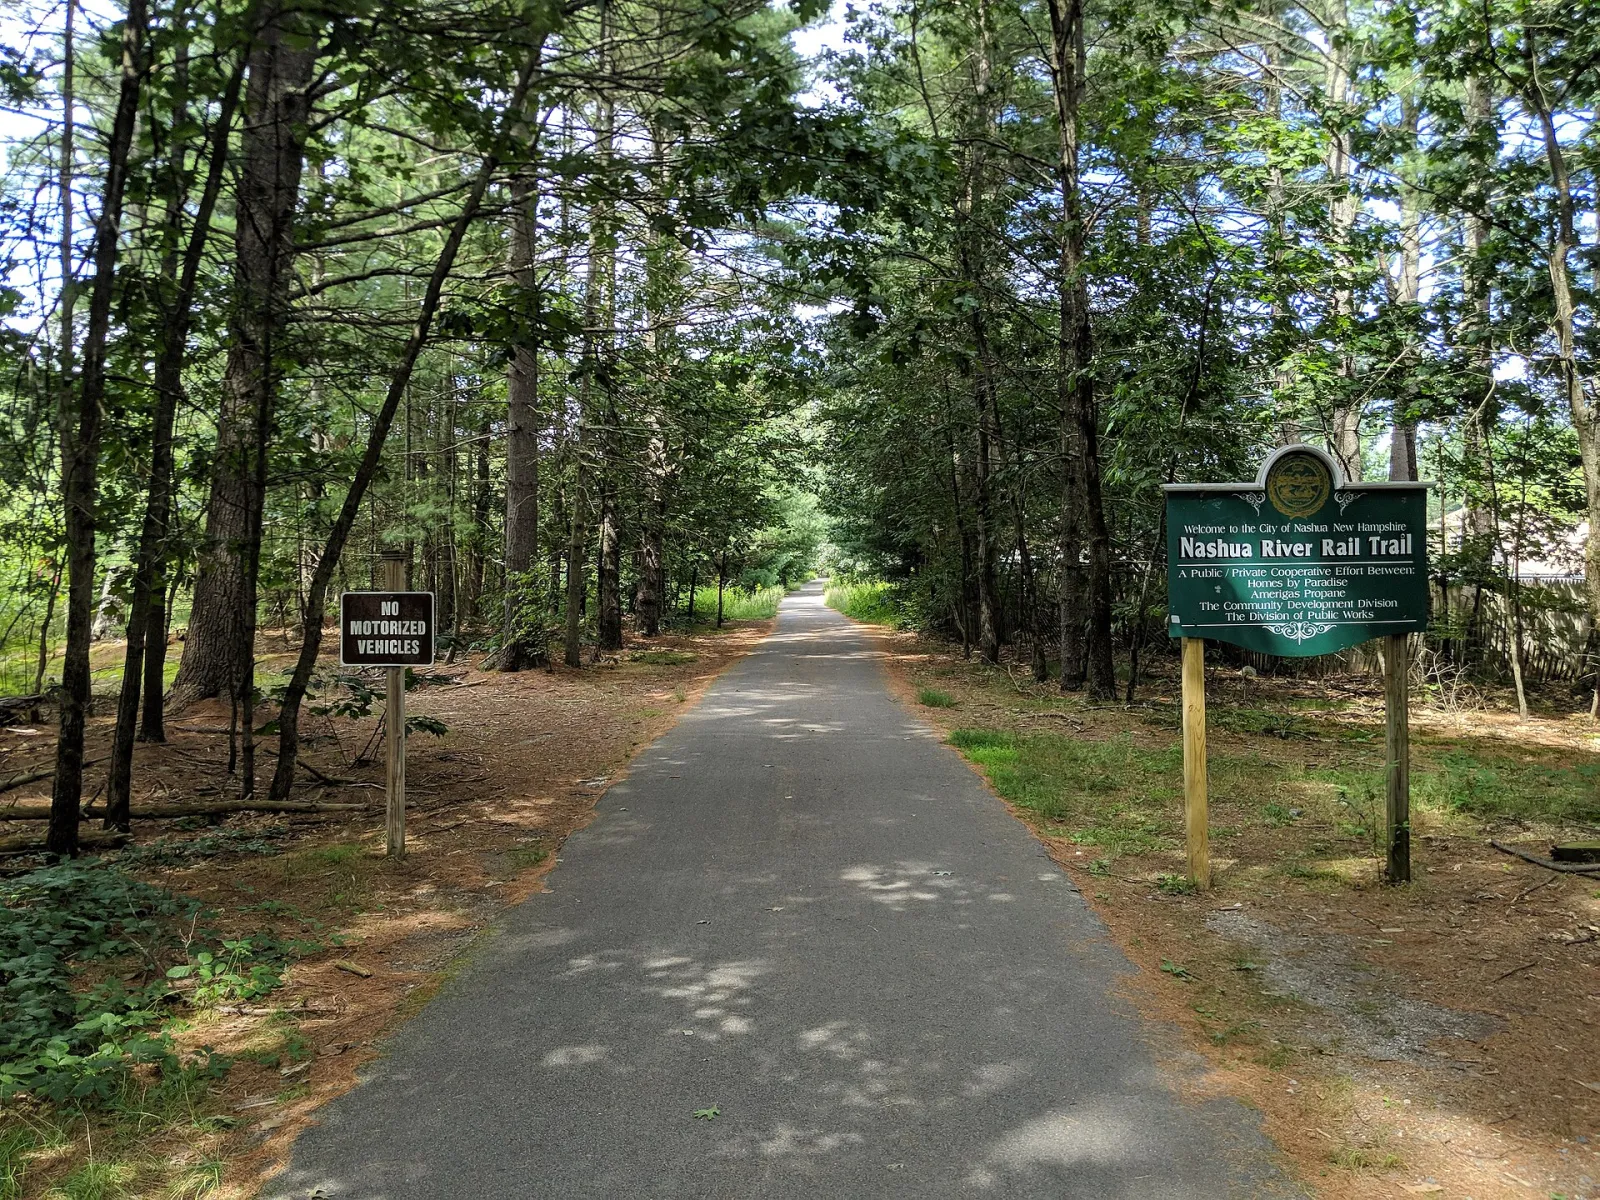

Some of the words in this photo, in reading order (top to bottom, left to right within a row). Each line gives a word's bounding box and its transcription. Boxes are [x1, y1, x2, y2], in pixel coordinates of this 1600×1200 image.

[1184, 525, 1226, 534] Welcome
[1229, 525, 1238, 533] to
[1242, 524, 1256, 533] the
[1259, 523, 1278, 535] City
[1281, 523, 1290, 533] of
[1293, 523, 1328, 533] Nashua
[1333, 523, 1354, 532] New
[1357, 522, 1407, 533] Hampshire
[1180, 536, 1253, 558] Nashua
[1261, 539, 1313, 557] River
[1321, 537, 1360, 556] Rail
[1368, 533, 1412, 555] Trail
[1178, 569, 1187, 578] A
[1270, 566, 1332, 578] Cooperative
[1335, 565, 1364, 576] Effort
[1367, 566, 1416, 575] Between:
[1247, 579, 1283, 588] Homes
[1287, 579, 1300, 589] by
[1304, 578, 1348, 587] Paradise
[1250, 590, 1300, 600] Amerigas
[1304, 589, 1346, 599] Propane
[381, 601, 399, 616] NO
[1199, 601, 1220, 611] The
[1223, 601, 1283, 611] Community
[1287, 600, 1354, 611] Development
[1358, 598, 1398, 608] Division
[1225, 612, 1246, 621] The
[1249, 611, 1290, 621] Division
[1293, 611, 1304, 620] of
[1307, 610, 1339, 620] Public
[1342, 609, 1374, 619] Works
[350, 620, 426, 635] MOTORIZED
[357, 639, 420, 655] VEHICLES
